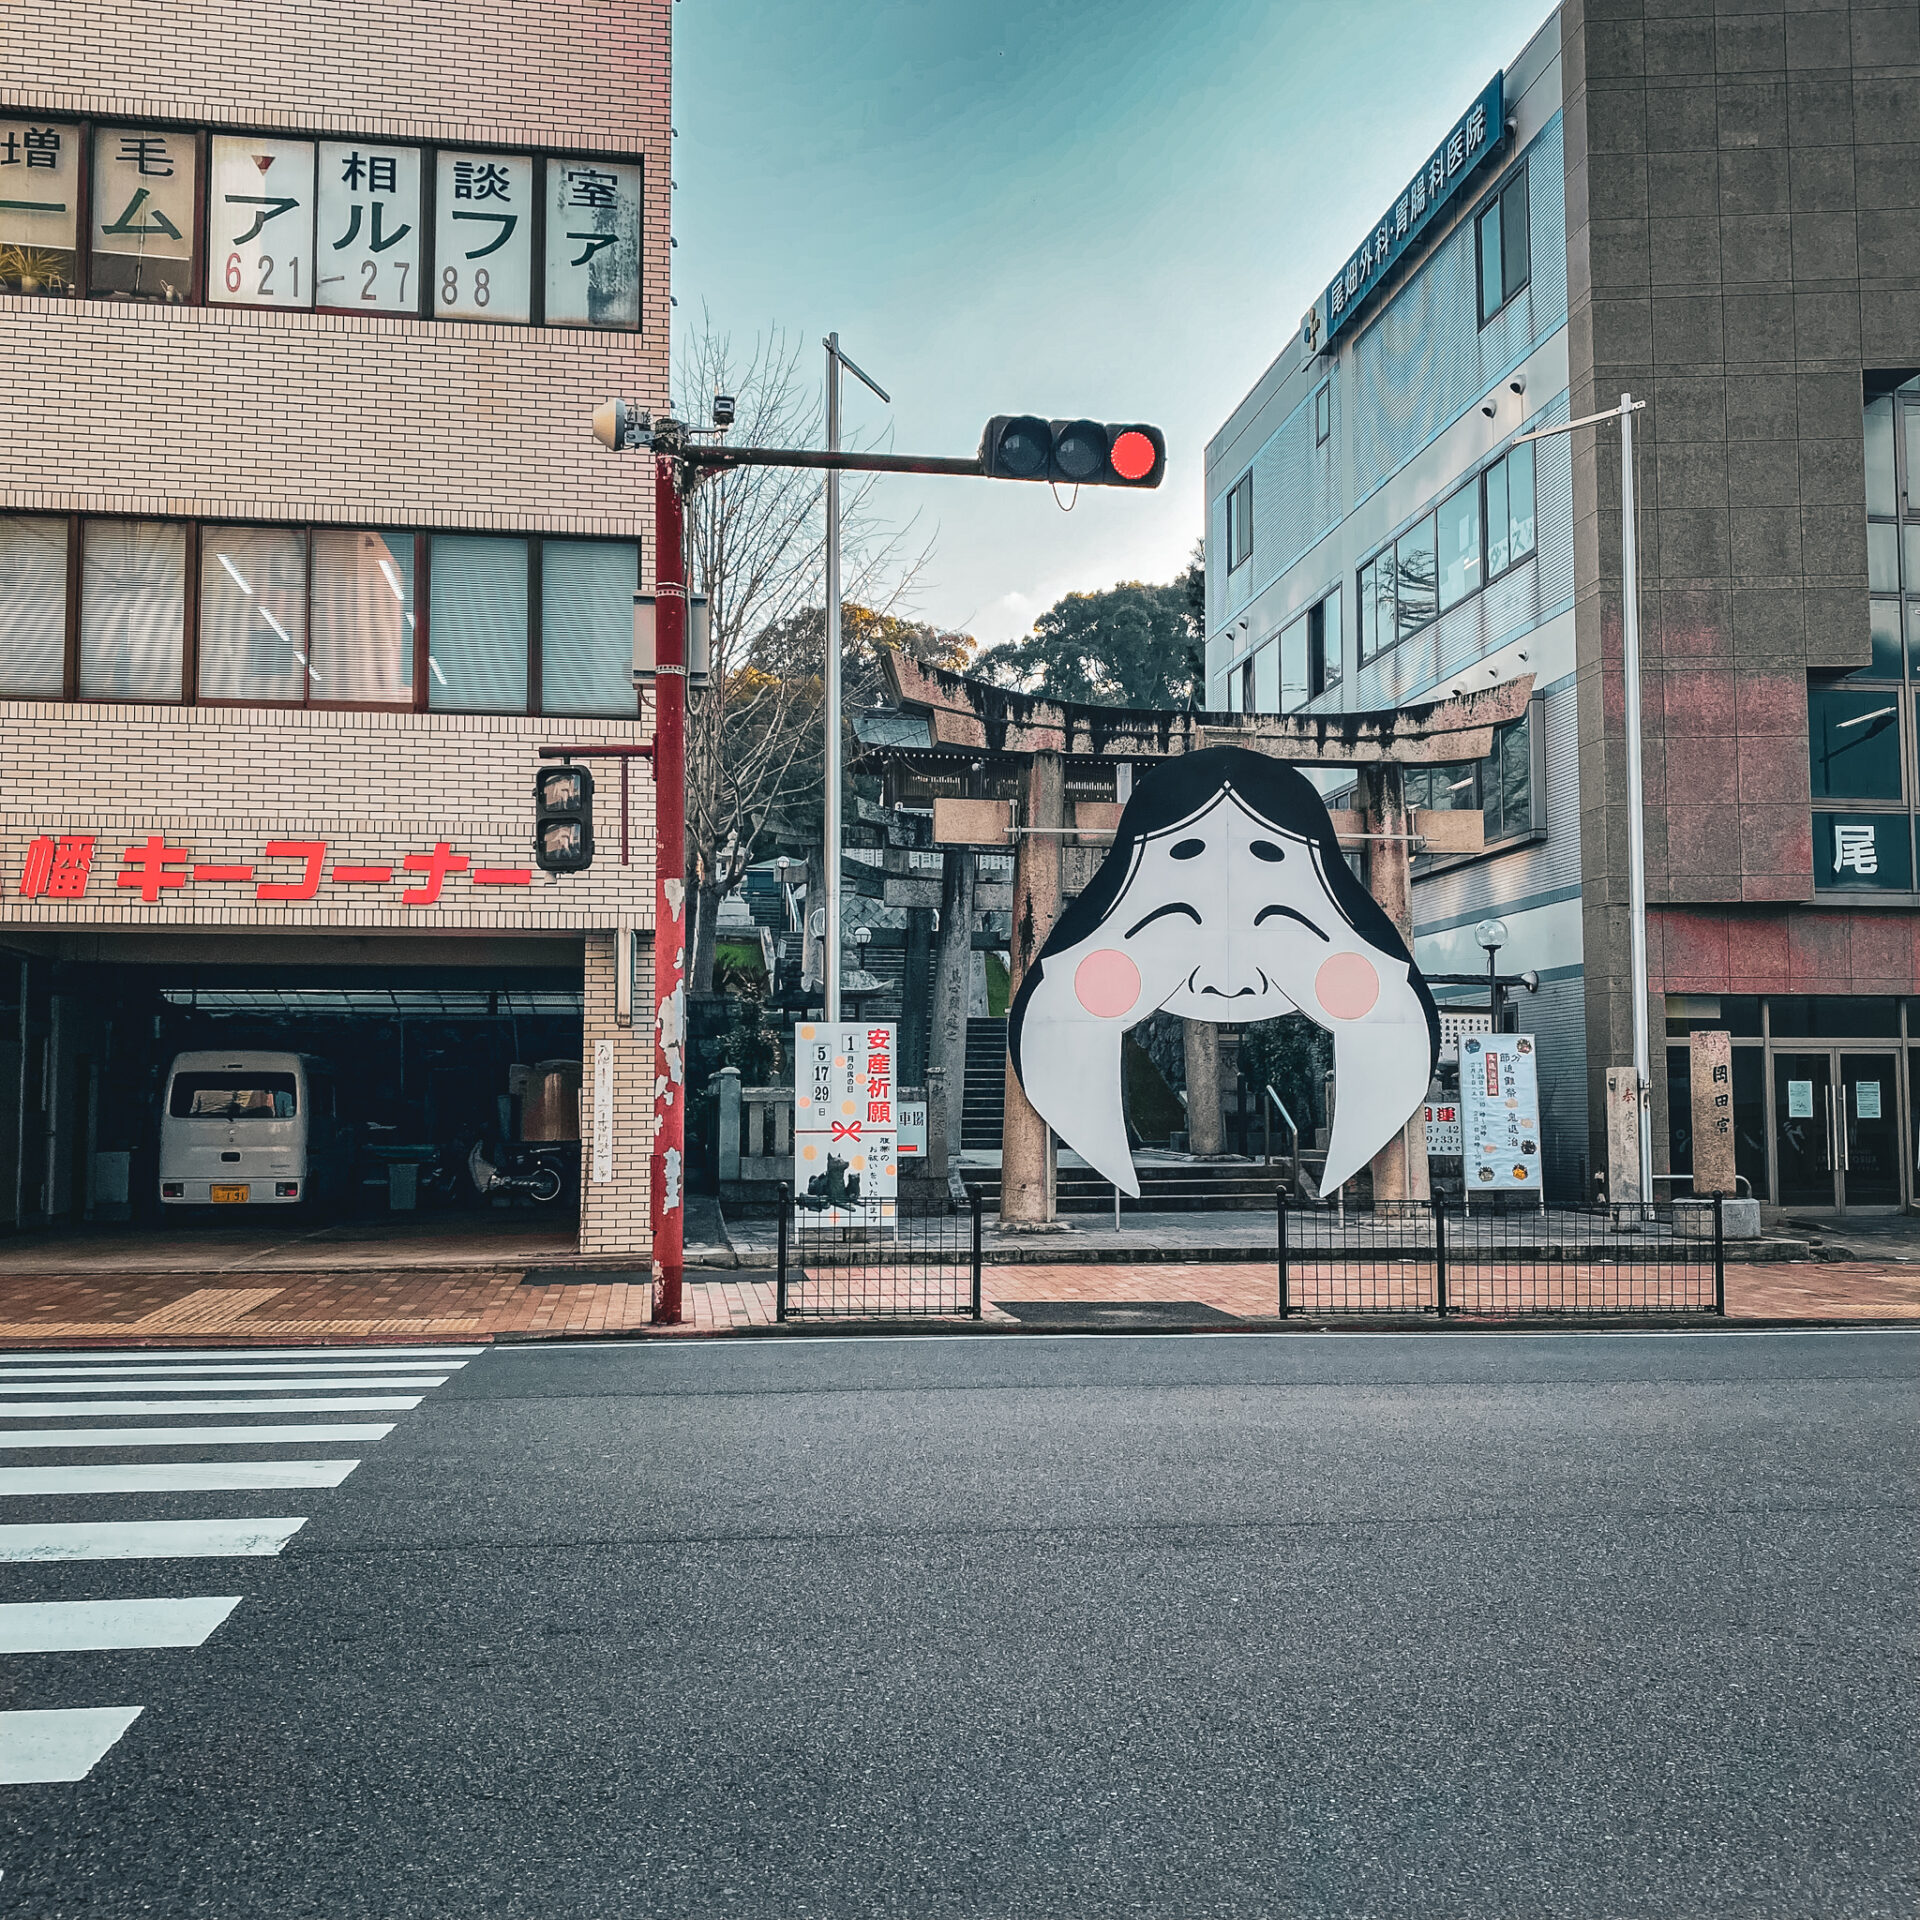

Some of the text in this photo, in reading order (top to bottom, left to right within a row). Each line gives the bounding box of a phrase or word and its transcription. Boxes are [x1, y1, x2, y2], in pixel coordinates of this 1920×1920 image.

[20, 834, 532, 904] 幡キーコーナー
[1833, 825, 1879, 874] 尾
[815, 1066, 829, 1082] 17
[818, 1046, 826, 1062] 5
[866, 1028, 891, 1124] 安産祈願
[814, 1086, 829, 1102] 29
[1712, 1064, 1730, 1134] 岡田宮
